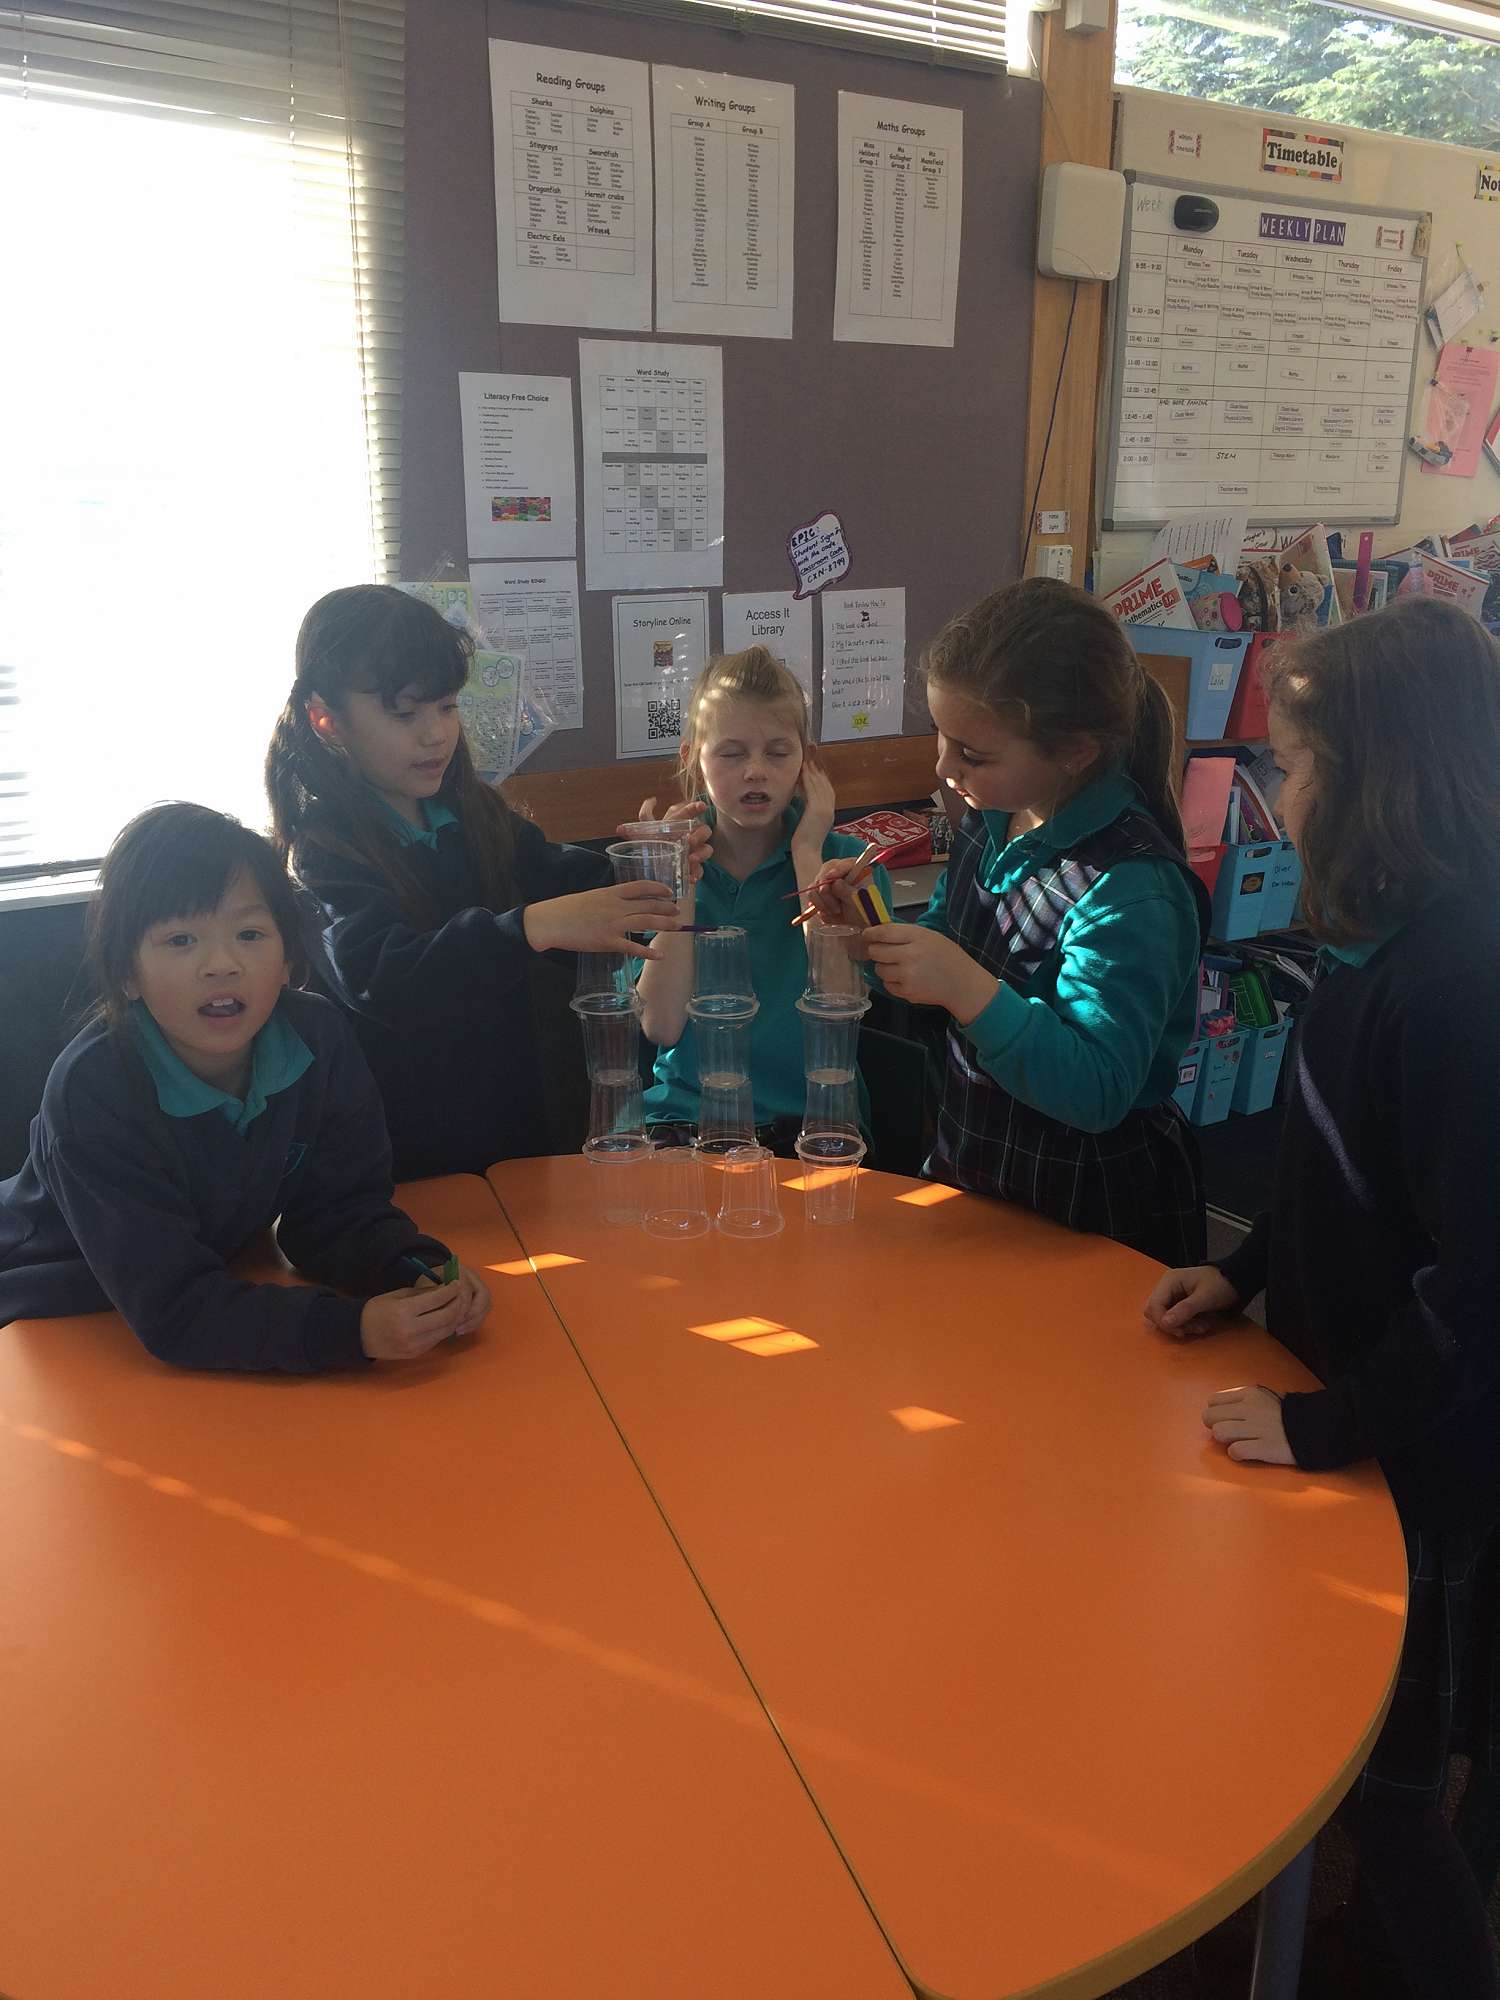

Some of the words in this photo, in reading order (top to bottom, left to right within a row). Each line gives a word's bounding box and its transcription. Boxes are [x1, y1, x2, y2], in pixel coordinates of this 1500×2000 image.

[536, 72, 572, 90] Reading
[575, 78, 606, 93] Groups
[531, 97, 553, 108] Sharks
[694, 96, 726, 112] Writing
[728, 100, 756, 114] Groups
[589, 105, 615, 116] Dolphins
[687, 118, 705, 128] Group
[742, 125, 759, 135] Group
[876, 121, 899, 133] Maths
[901, 124, 926, 137] Groups
[529, 140, 558, 152] Stingrays
[588, 148, 619, 159] Swordfish
[1266, 142, 1338, 169] Timetable
[1480, 174, 1500, 191] No
[528, 184, 562, 195] Dragonfish
[584, 190, 606, 200] Hermit
[1262, 218, 1310, 242] WEEKLY
[1315, 223, 1345, 244] PLAN
[527, 232, 551, 242] Electric
[553, 234, 565, 243] Eels
[1183, 245, 1204, 257] Monday
[1238, 250, 1259, 260] Tuesday
[1285, 255, 1313, 264] Wednesday
[1338, 260, 1360, 269] Thursday
[1387, 264, 1403, 273] Friday
[654, 370, 670, 378] Study
[484, 393, 510, 402] Literacy
[527, 394, 549, 402] Choice
[792, 528, 815, 547] EPIC
[1426, 570, 1459, 592] PRIME
[1112, 577, 1165, 618] PRIME
[746, 610, 781, 622] Access
[633, 618, 667, 629] Storyline
[668, 616, 692, 626] Online
[751, 625, 785, 637] Library
